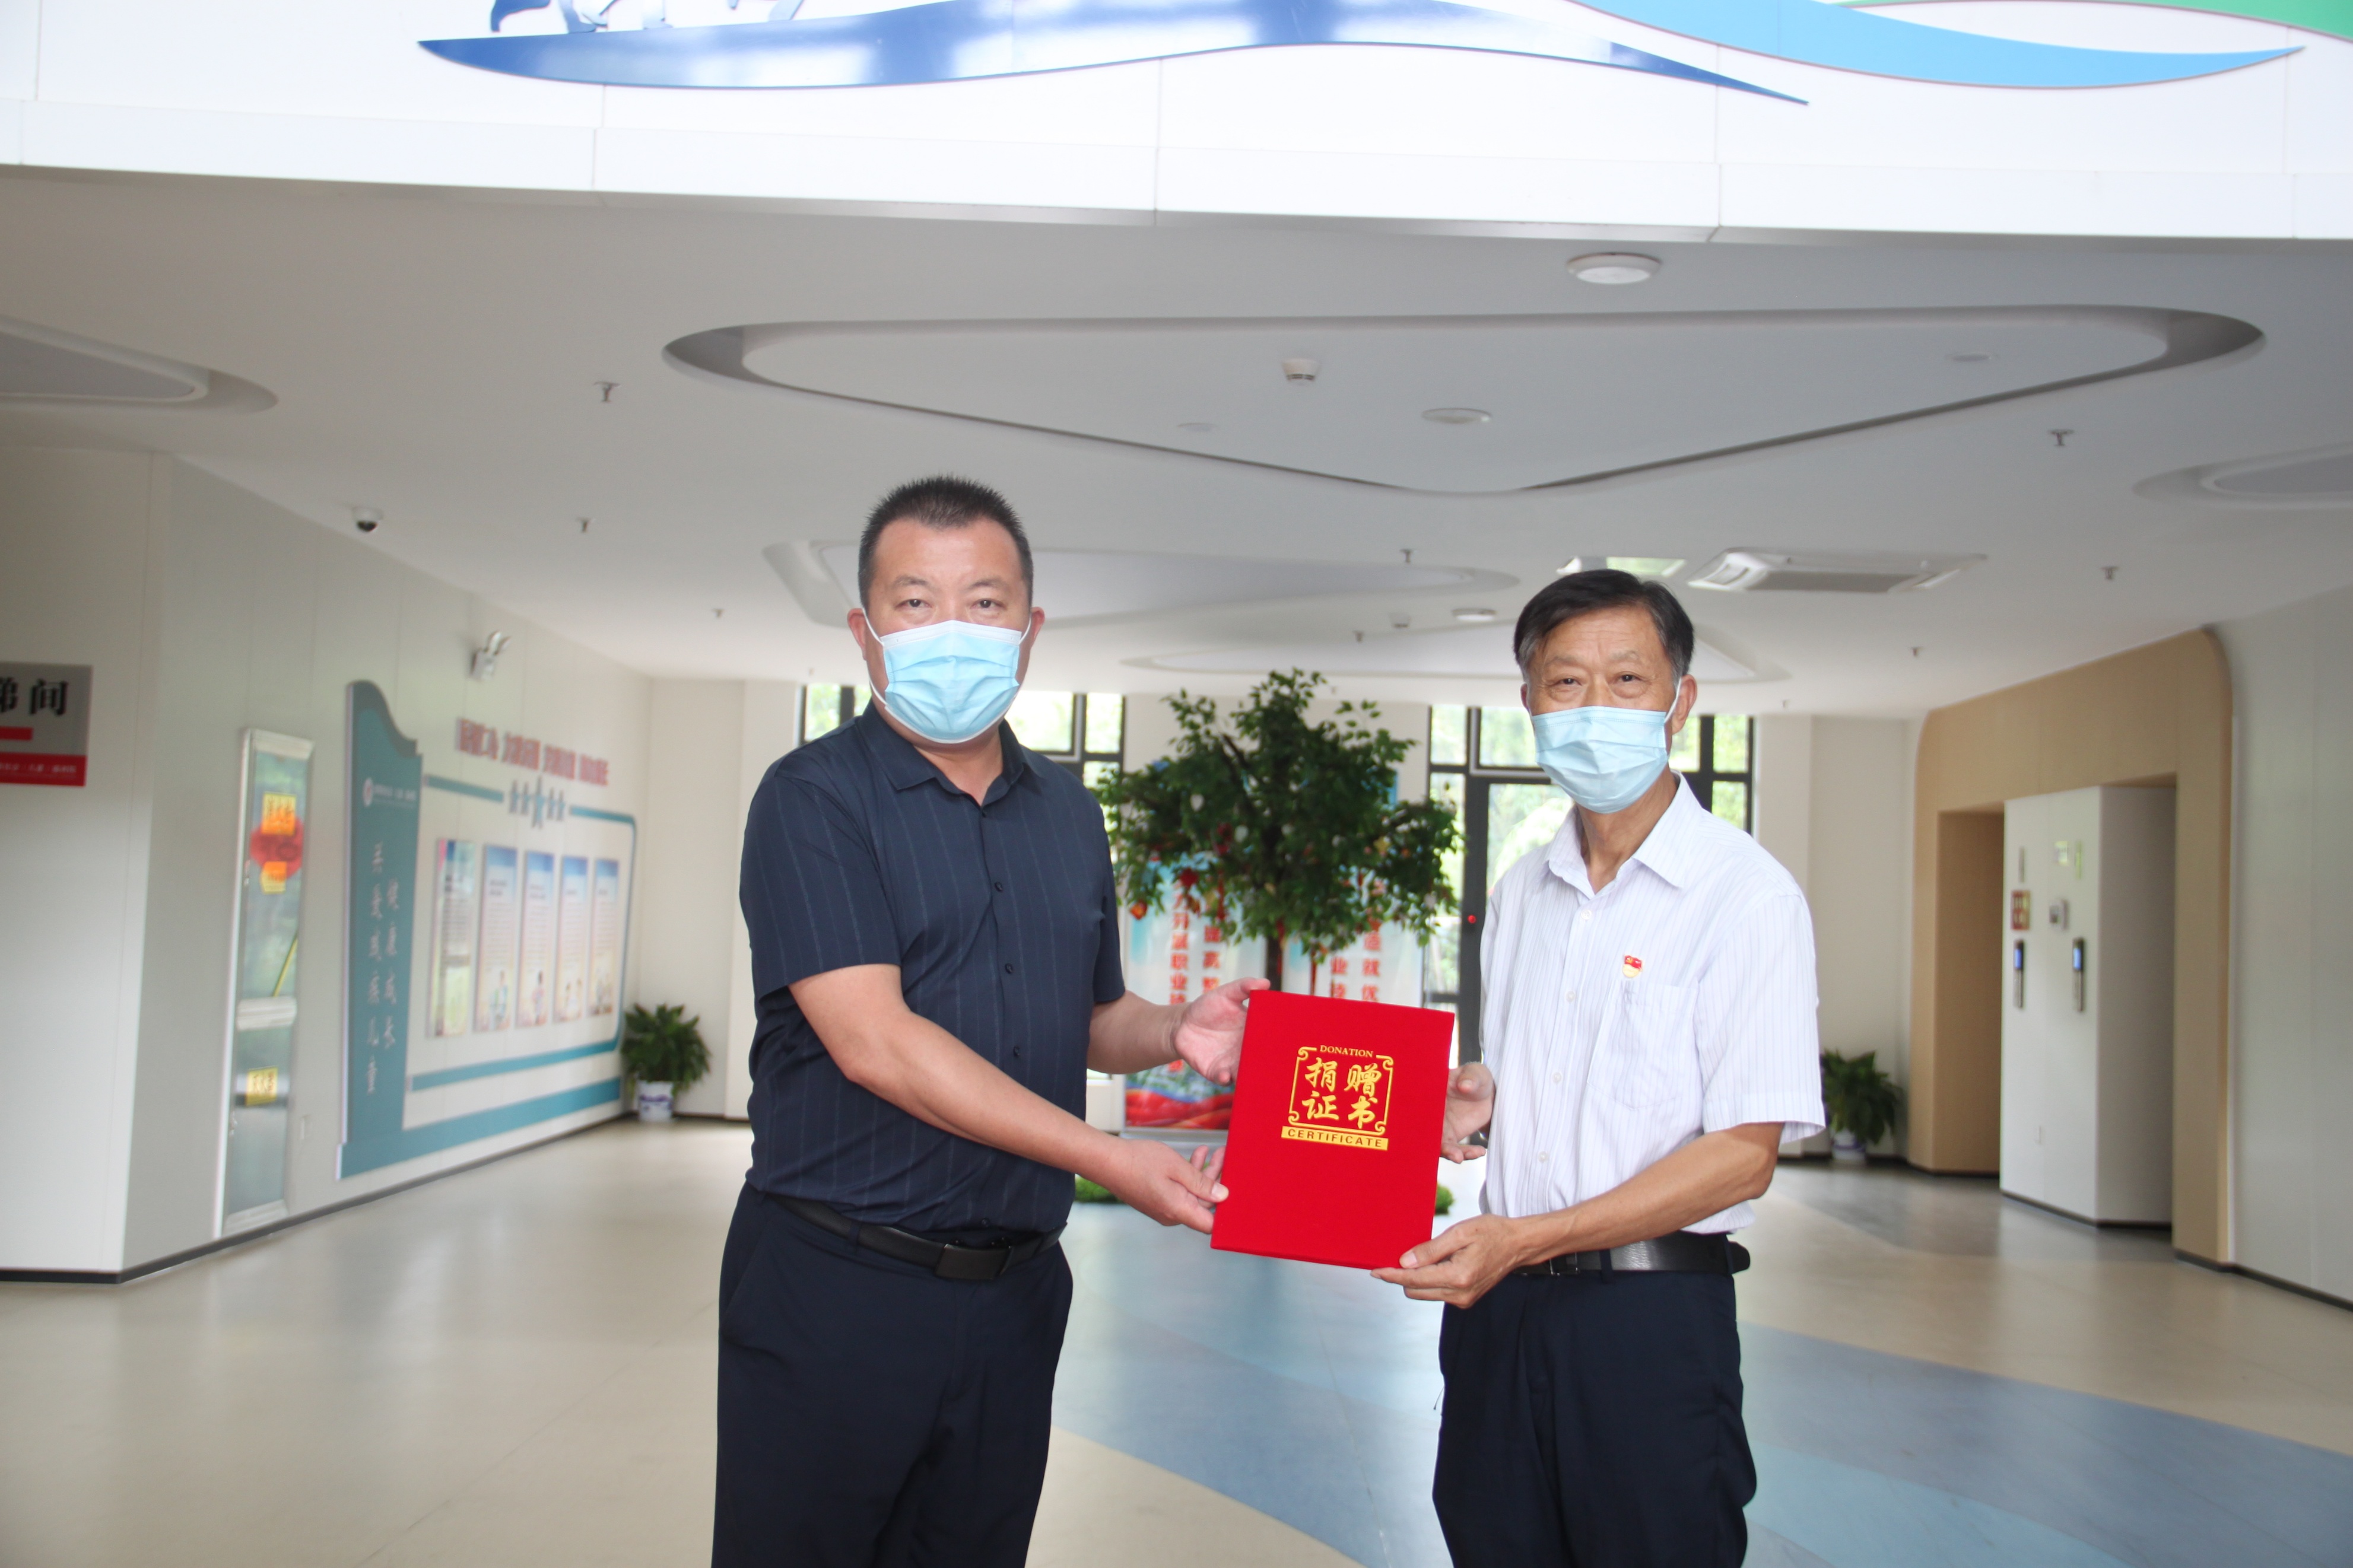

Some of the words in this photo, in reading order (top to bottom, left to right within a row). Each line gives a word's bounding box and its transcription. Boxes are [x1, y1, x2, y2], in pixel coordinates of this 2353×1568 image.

[1319, 1045, 1374, 1058] DONATION
[1304, 1057, 1382, 1097] 捐赠
[1301, 1093, 1377, 1130] 证书
[1287, 1128, 1382, 1148] CERTIFICATE
